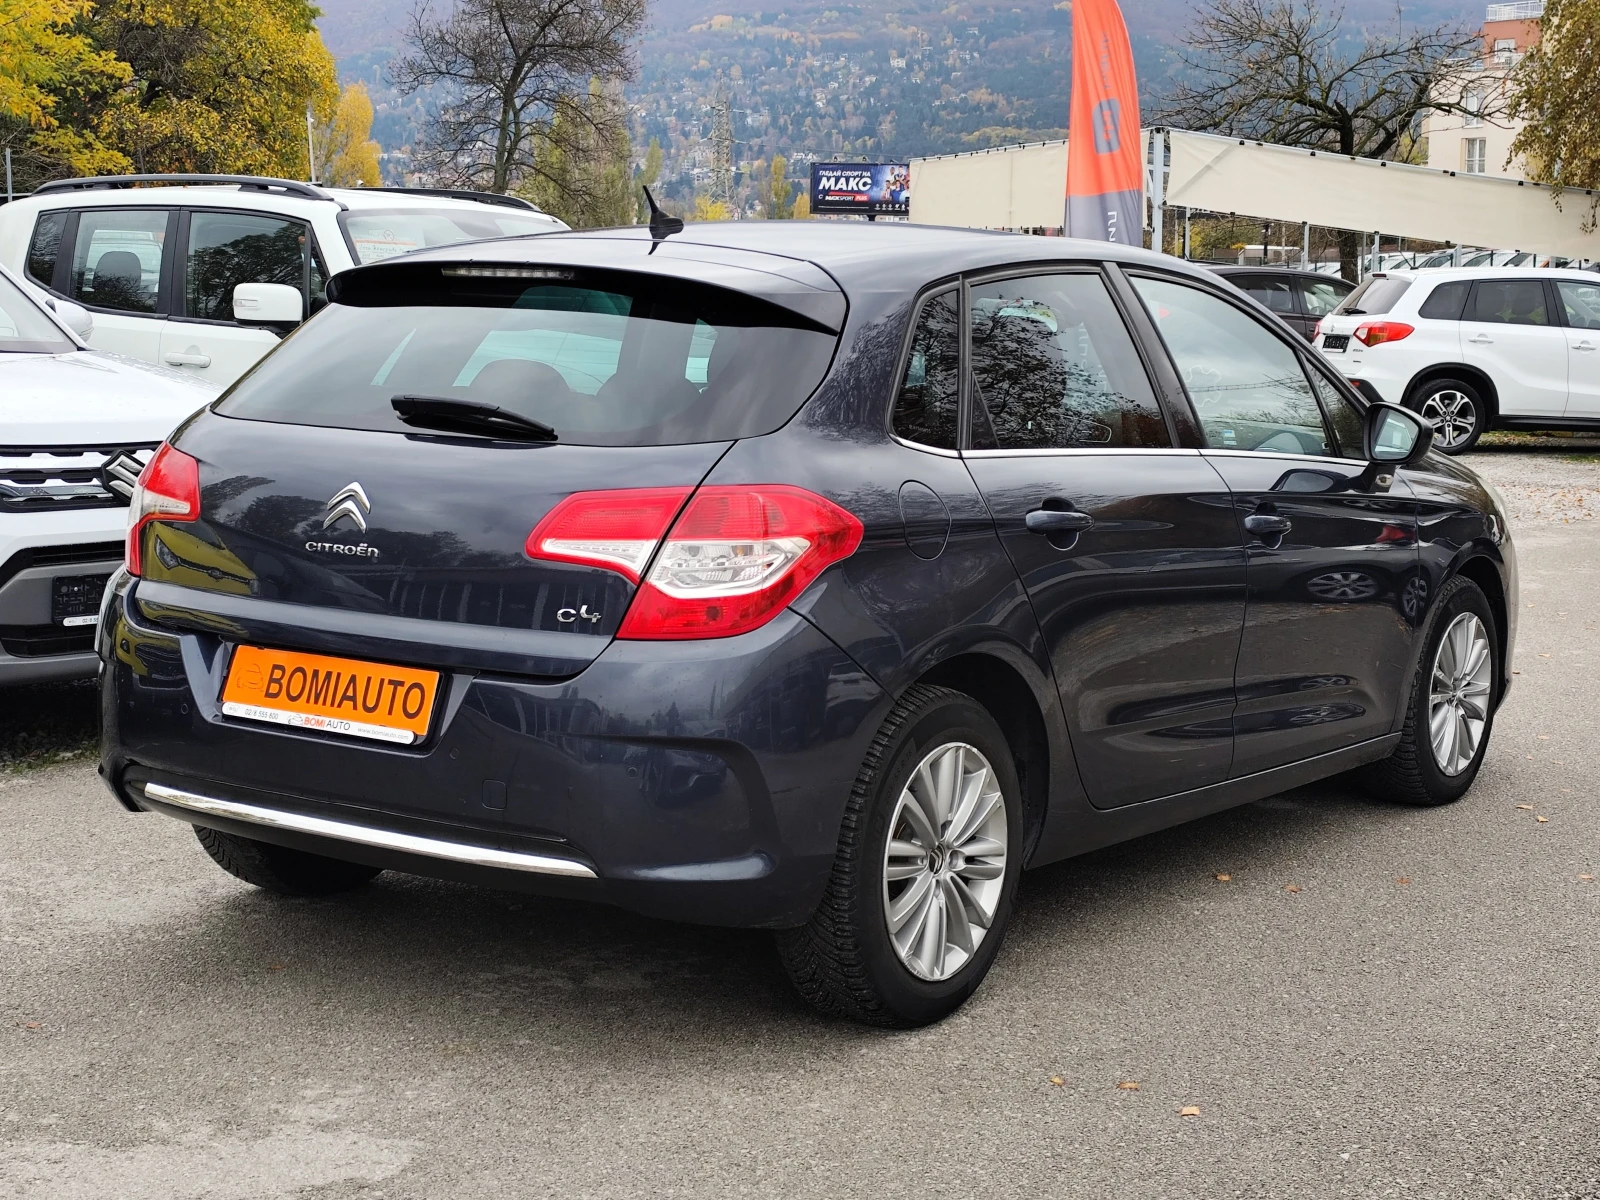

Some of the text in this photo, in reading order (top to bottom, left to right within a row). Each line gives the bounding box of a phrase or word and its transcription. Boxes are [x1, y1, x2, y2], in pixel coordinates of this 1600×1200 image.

[819, 177, 872, 191] МАКС
[557, 605, 601, 623] C4
[264, 664, 425, 719] BOMIAUTO
[258, 710, 268, 718] 555
[304, 716, 351, 731] BOMI AUTO
[357, 727, 409, 741] www.bomiauto.com
